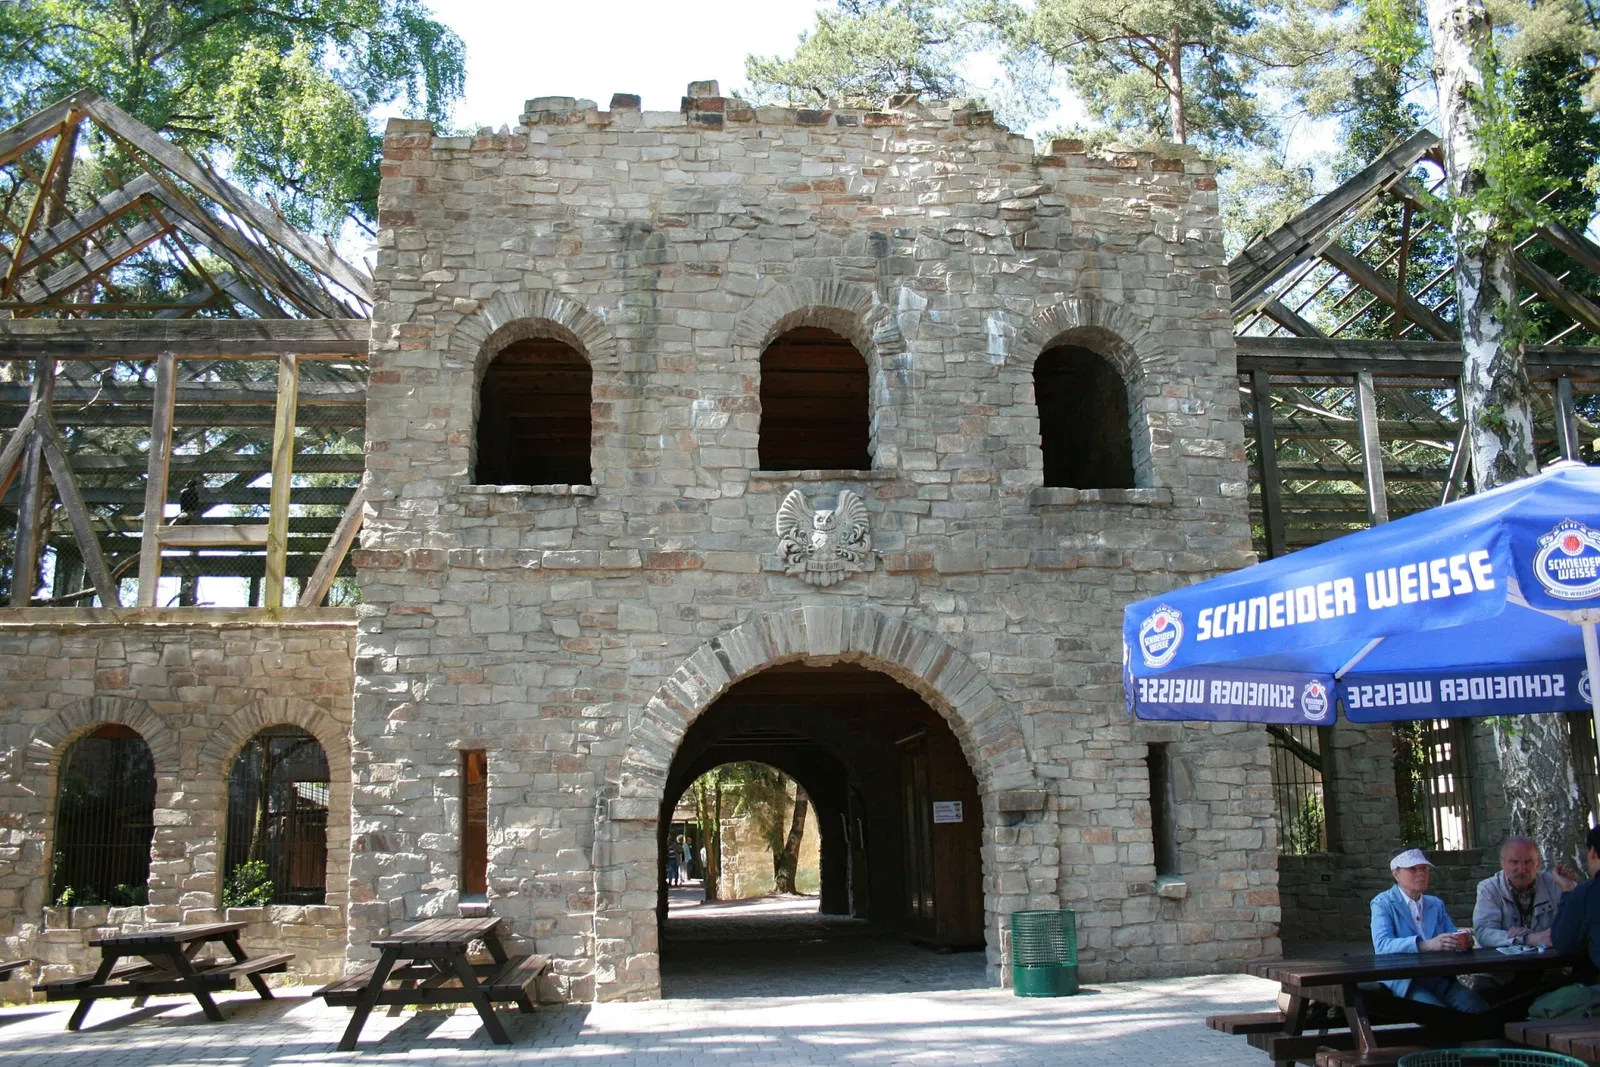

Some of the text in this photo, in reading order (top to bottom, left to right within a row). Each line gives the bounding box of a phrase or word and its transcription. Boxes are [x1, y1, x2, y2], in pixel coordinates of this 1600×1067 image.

[1196, 550, 1495, 641] SCHNEIDER WEISSE
[1557, 567, 1597, 580] WEISSE
